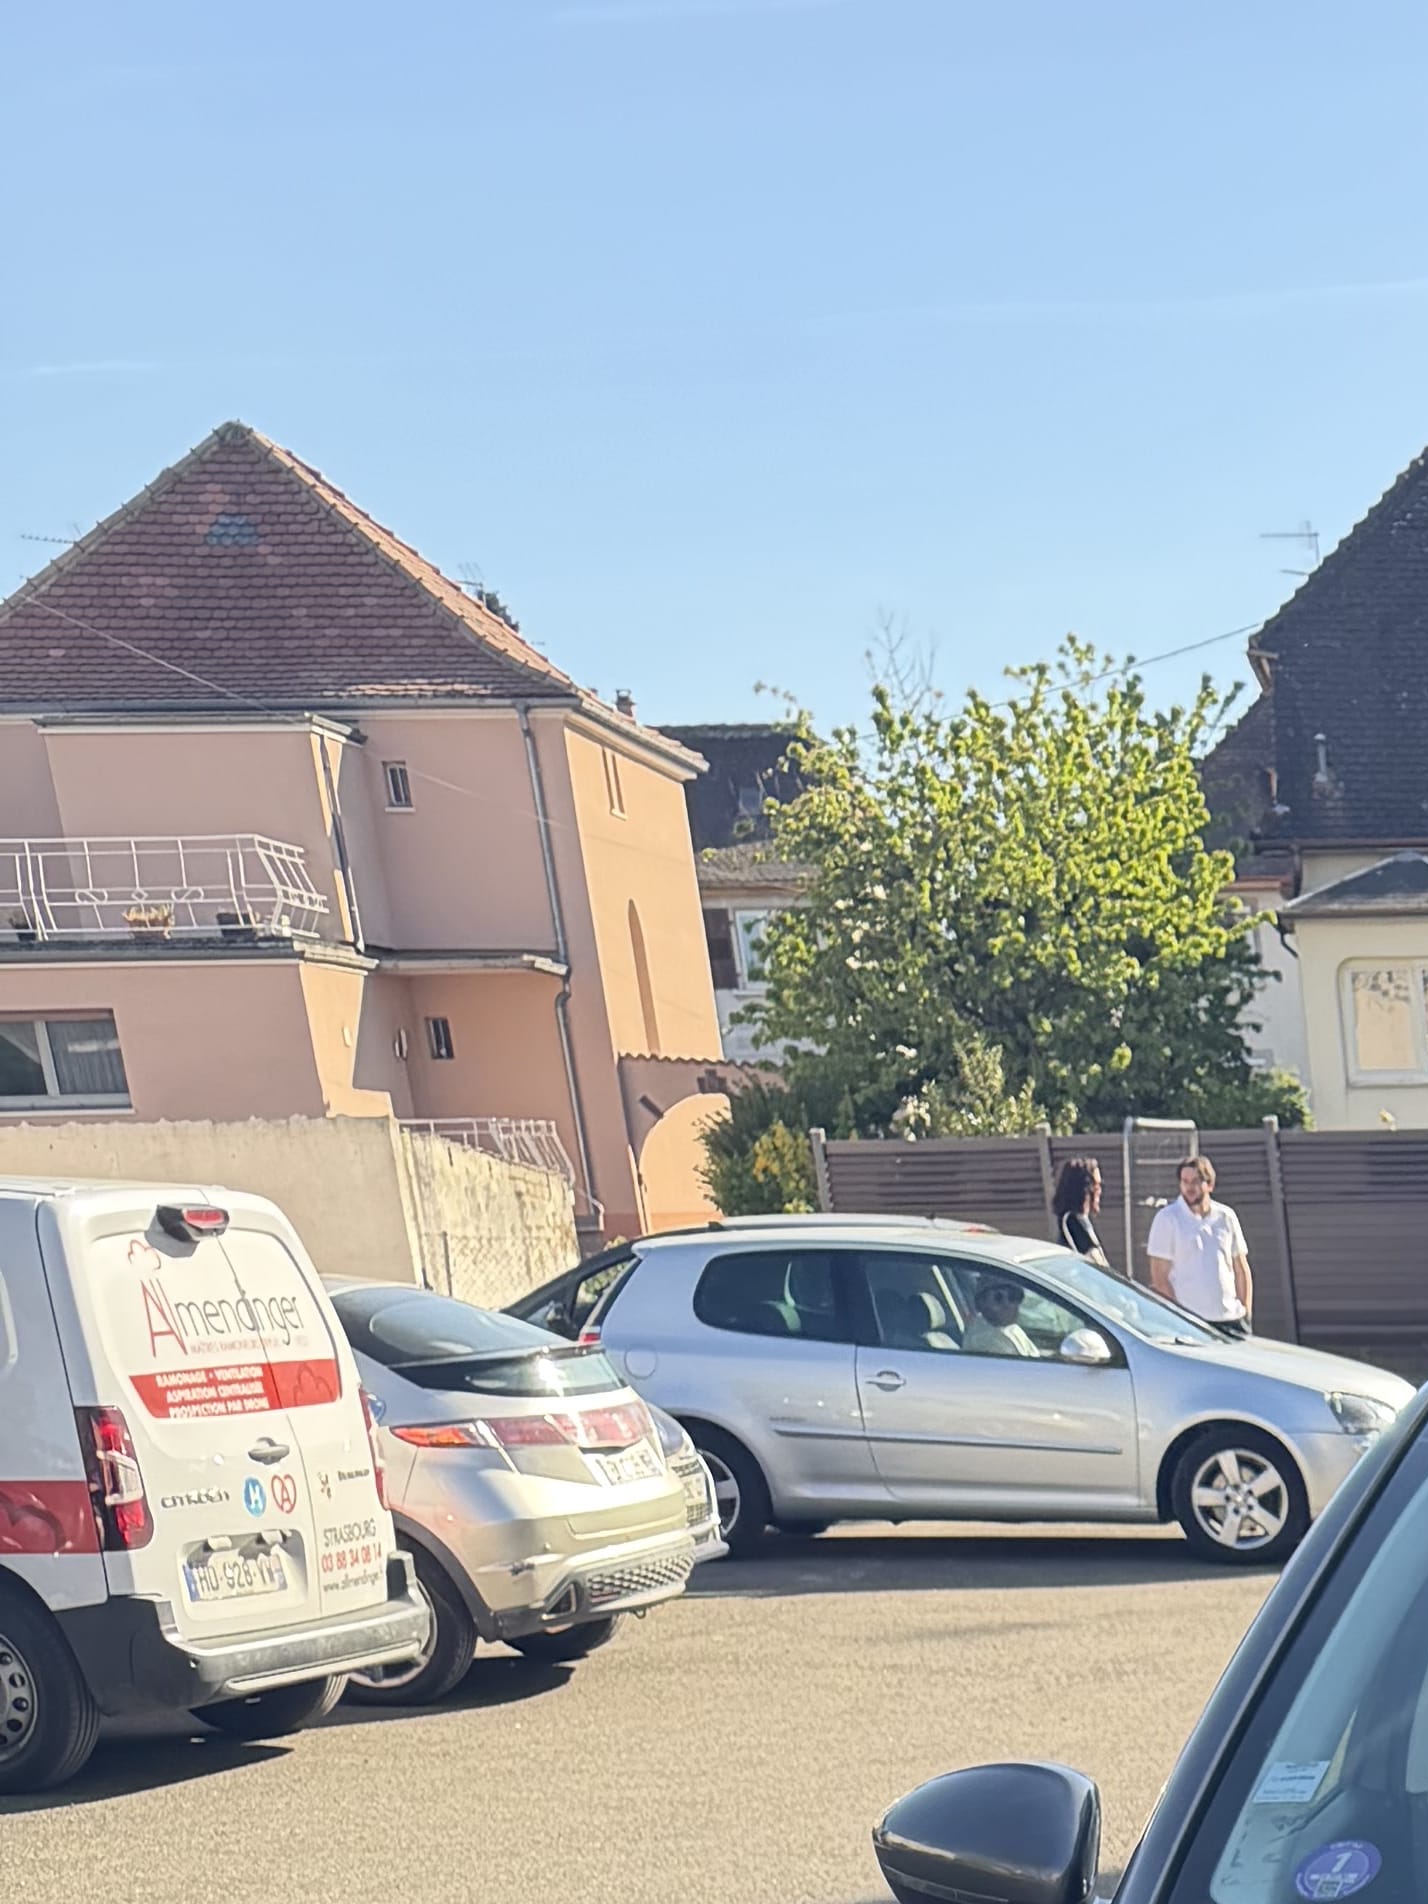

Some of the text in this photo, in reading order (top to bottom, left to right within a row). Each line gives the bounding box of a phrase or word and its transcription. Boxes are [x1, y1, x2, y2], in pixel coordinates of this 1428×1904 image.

[323, 1518, 377, 1547] STRASBOURG
[321, 1555, 333, 1573] 03
[1332, 1852, 1353, 1873] 1
